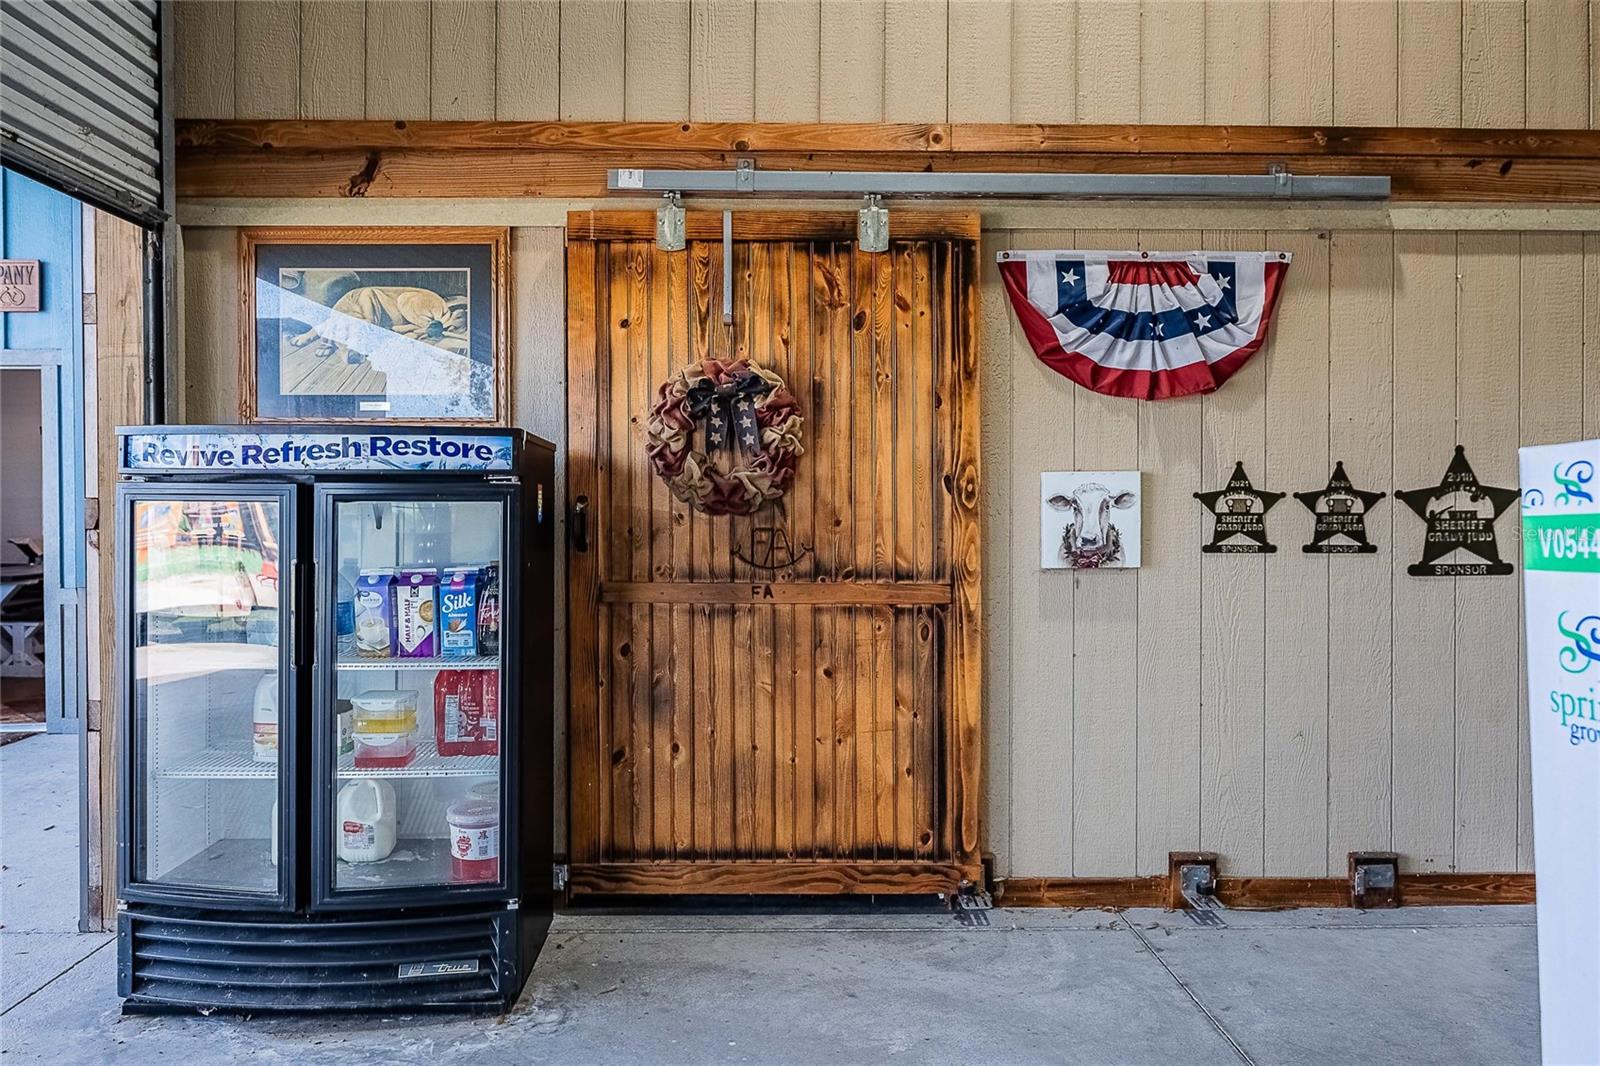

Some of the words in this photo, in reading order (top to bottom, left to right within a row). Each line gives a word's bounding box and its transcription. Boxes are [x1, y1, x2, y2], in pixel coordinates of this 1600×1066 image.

[143, 441, 234, 467] Revive
[242, 436, 362, 465] Refresh
[369, 436, 493, 462] Restore
[1221, 515, 1258, 523] SHERIFF
[1435, 520, 1486, 530] SHERIFF
[1467, 532, 1494, 544] JUDD
[1221, 545, 1259, 553] SPONSOR
[1435, 565, 1487, 575] SPONSOR
[751, 585, 773, 599] FA
[442, 592, 474, 613] Silk
[1550, 687, 1600, 727] spri
